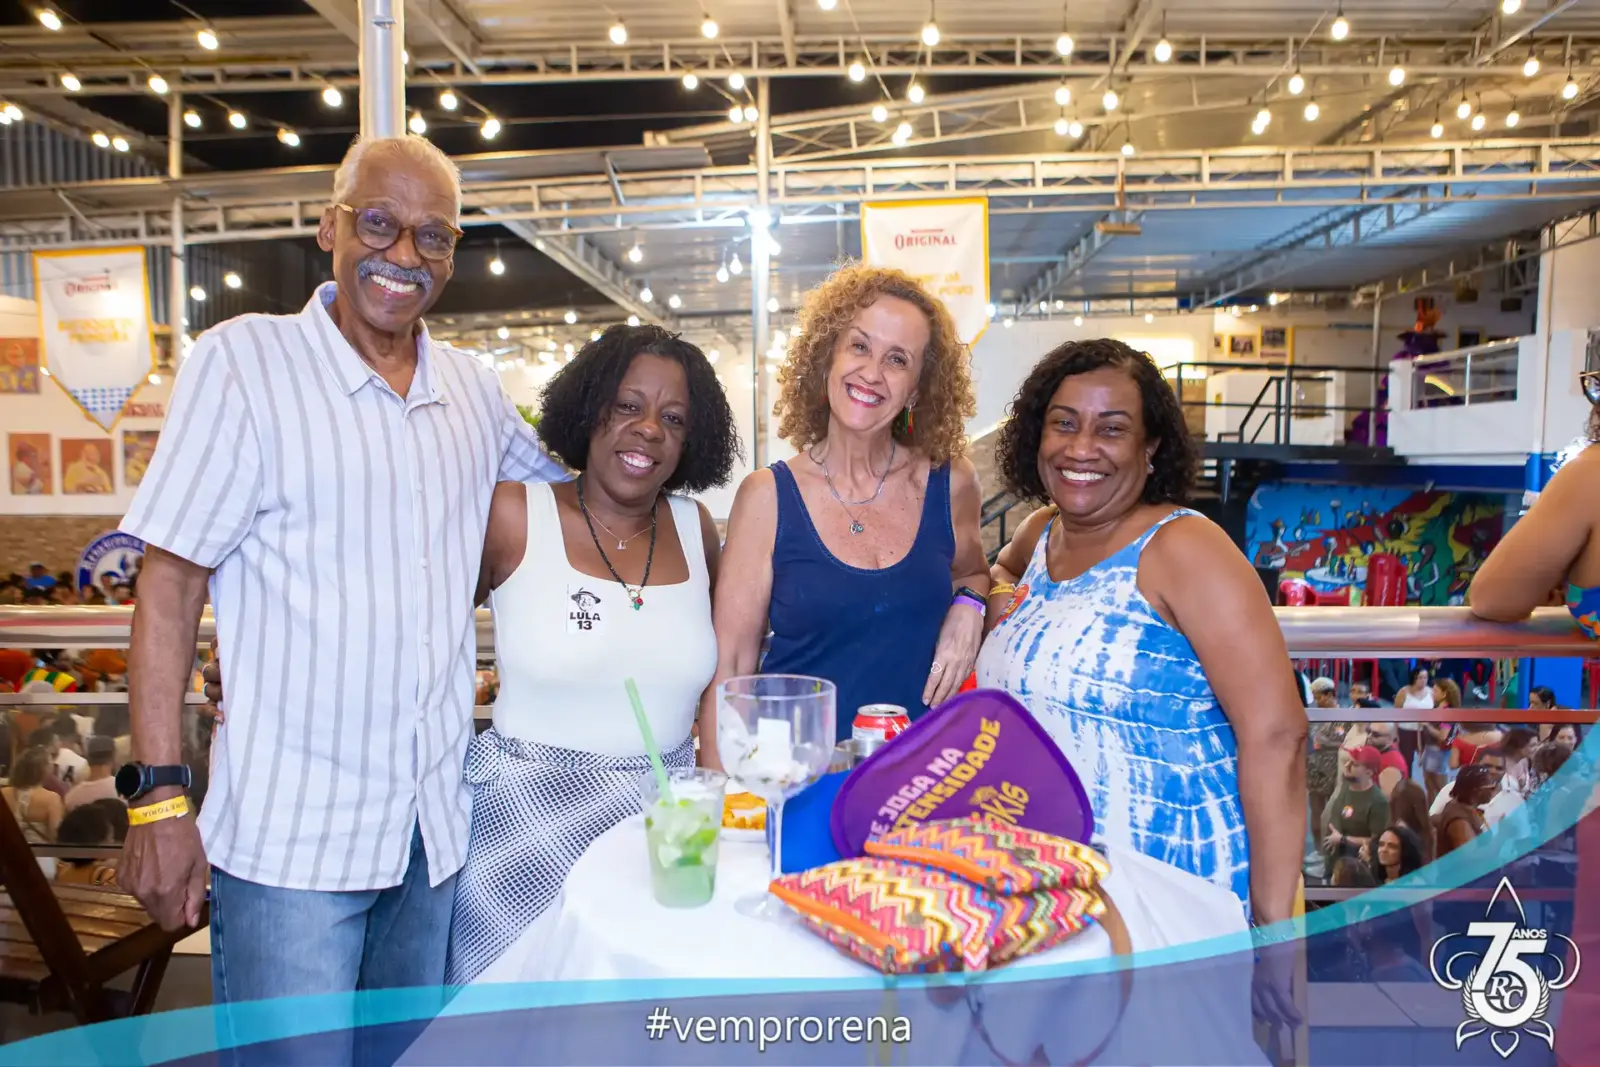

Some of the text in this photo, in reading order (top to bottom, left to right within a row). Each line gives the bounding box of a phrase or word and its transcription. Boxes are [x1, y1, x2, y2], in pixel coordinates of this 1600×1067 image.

[894, 233, 957, 250] ORIGINAL
[569, 611, 601, 621] LULA
[577, 620, 592, 630] 13
[890, 716, 1001, 834] TENSIDADE
[878, 775, 937, 822] JOGA
[926, 747, 965, 777] NA
